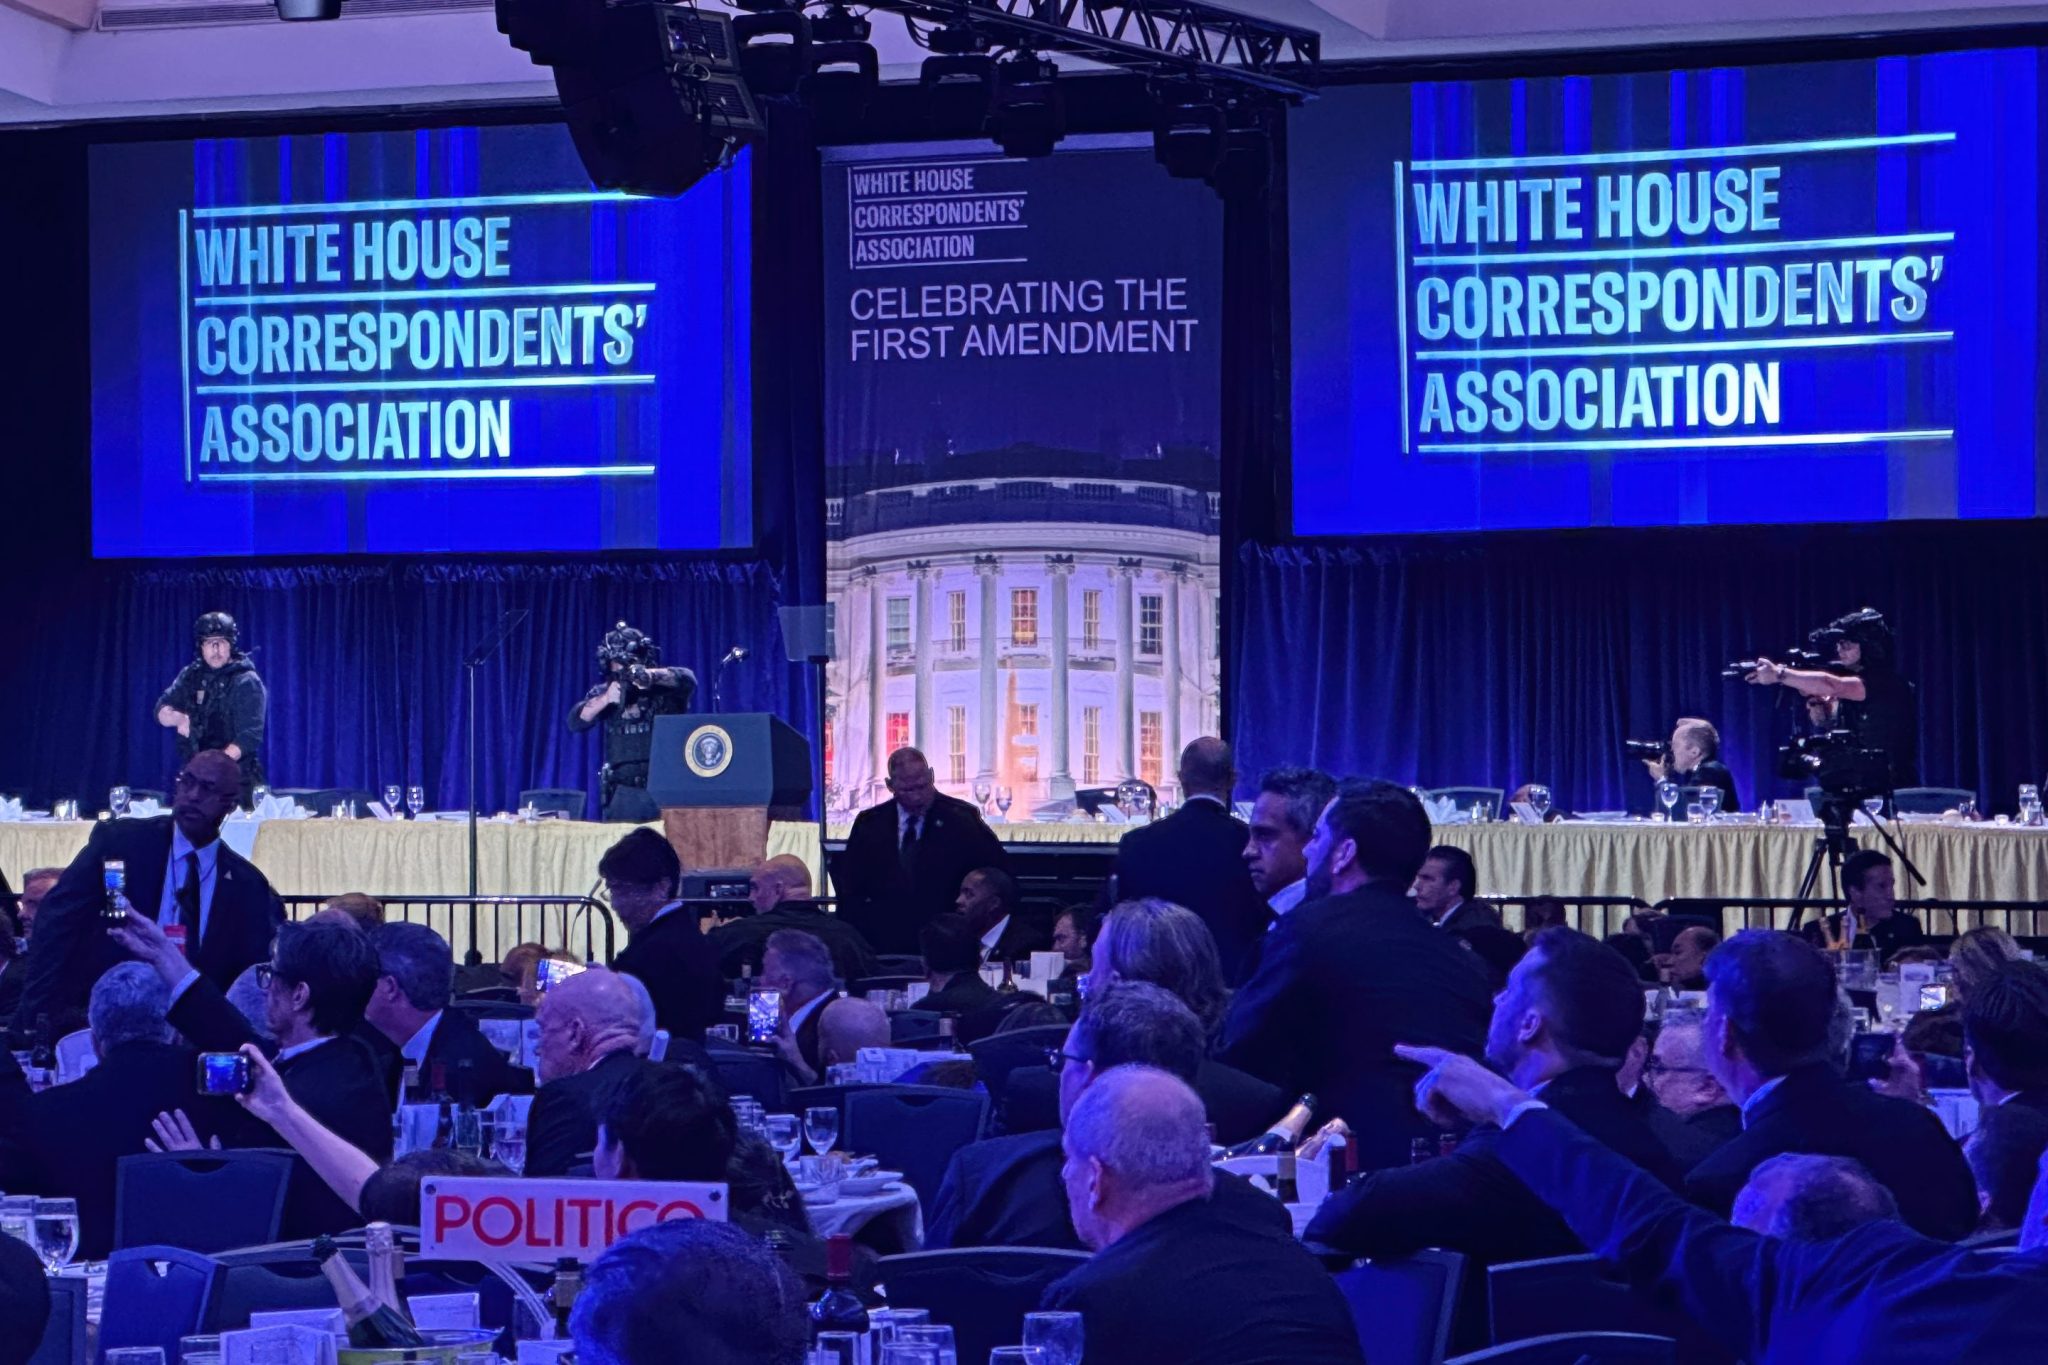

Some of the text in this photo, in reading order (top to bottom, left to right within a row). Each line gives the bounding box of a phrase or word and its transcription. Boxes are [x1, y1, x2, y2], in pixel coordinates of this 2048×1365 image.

[854, 168, 974, 195] WHITE HOUSE
[1413, 167, 1781, 245] WHITE HOUSE
[855, 200, 1025, 228] CORRESPONDENTS'
[194, 216, 511, 287] WHITE HOUSE
[856, 235, 975, 262] ASSOCIATION
[850, 278, 1188, 321] CELEBRATING THE
[1416, 256, 1943, 340] CORRESPONDENTS'
[197, 304, 648, 375] CORRESPONDENTS'
[851, 320, 1198, 361] FIRST AMENDMENT
[1420, 362, 1781, 433] ASSOCIATION
[200, 399, 511, 463] ASSOCIATION
